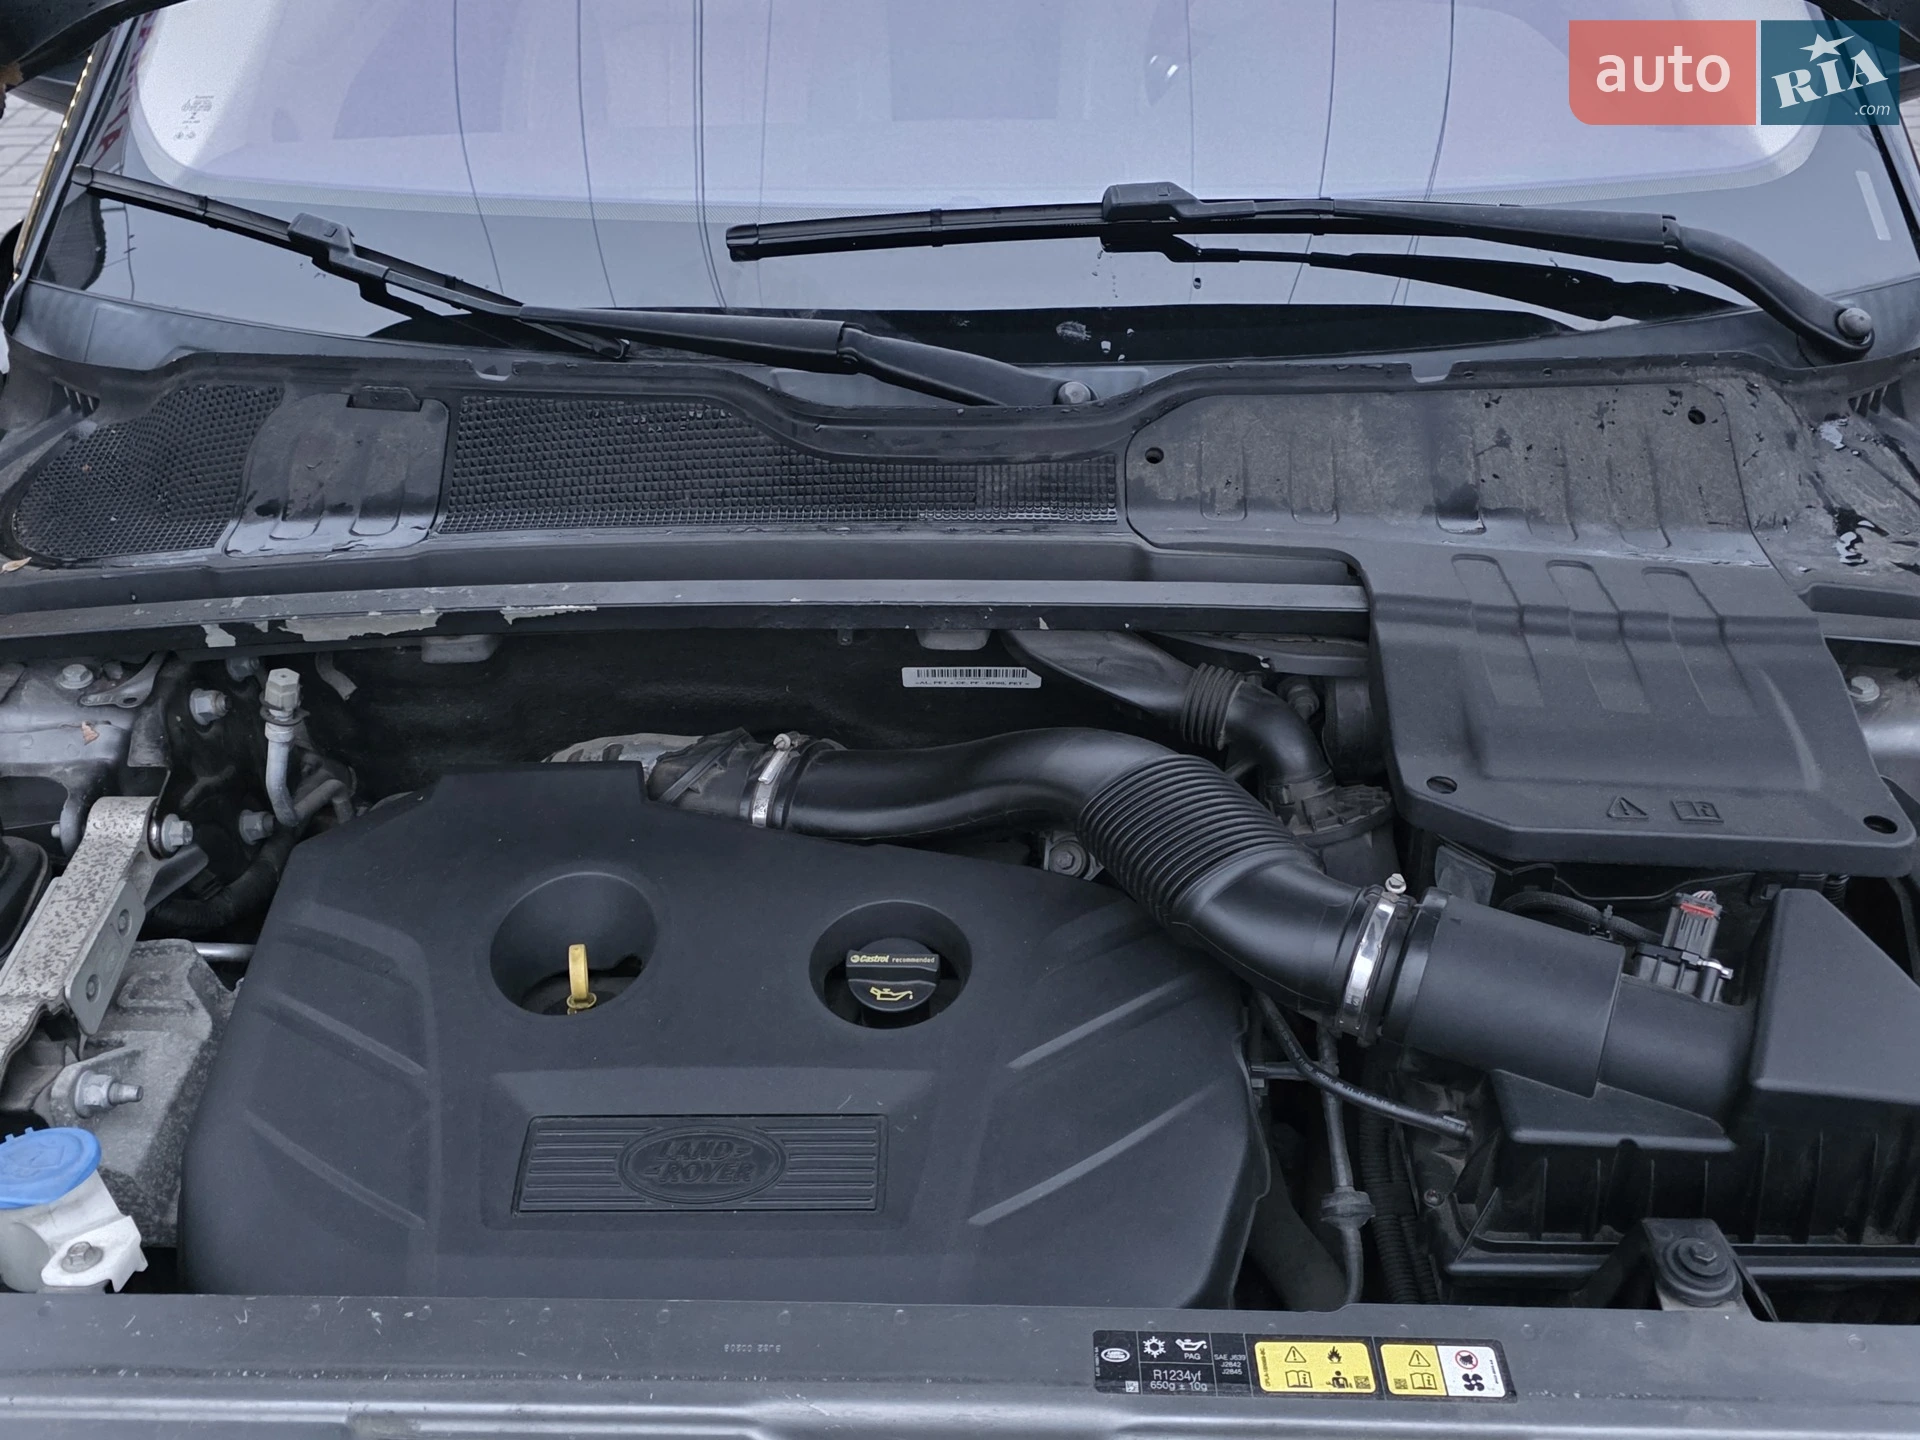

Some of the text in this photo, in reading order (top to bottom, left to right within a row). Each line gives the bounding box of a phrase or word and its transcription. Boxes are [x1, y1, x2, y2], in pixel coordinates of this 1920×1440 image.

[860, 954, 890, 963] Castrol
[658, 1140, 735, 1161] LAND
[658, 1161, 757, 1184] ROVER
[1184, 1352, 1201, 1360] PAG
[1153, 1369, 1202, 1383] R1234yf
[1150, 1380, 1176, 1391] 650g
[1189, 1381, 1208, 1392] 10g
